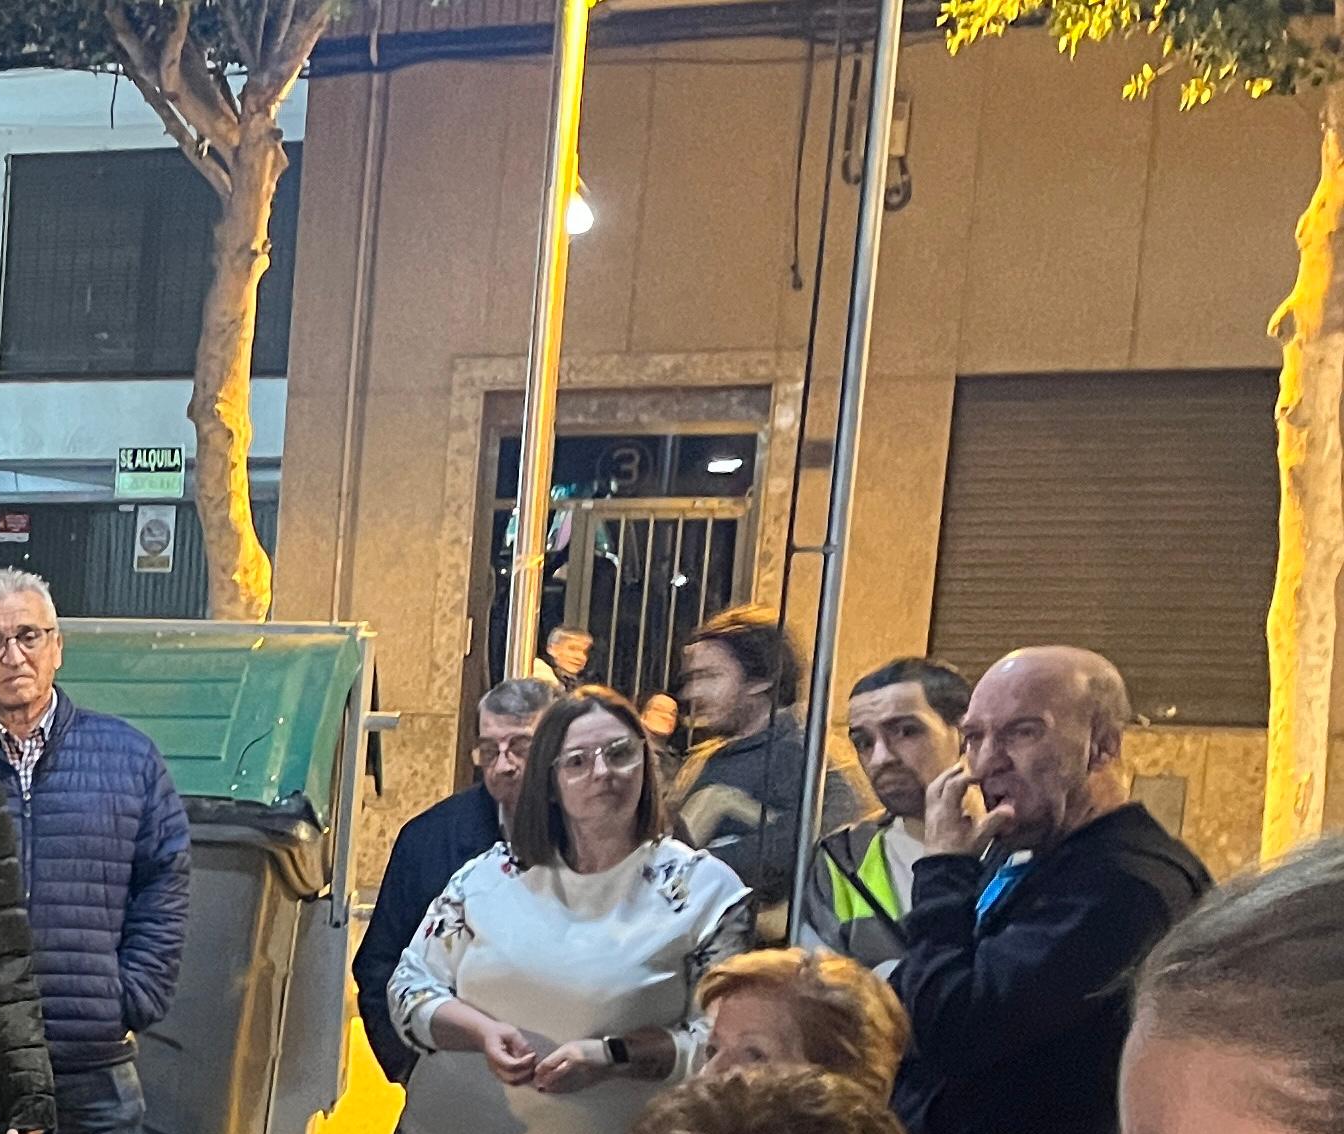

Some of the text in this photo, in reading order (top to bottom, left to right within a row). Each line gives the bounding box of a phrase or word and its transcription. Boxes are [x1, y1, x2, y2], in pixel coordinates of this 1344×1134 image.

[119, 448, 181, 472] SE ALQUILA
[612, 447, 640, 485] 3
